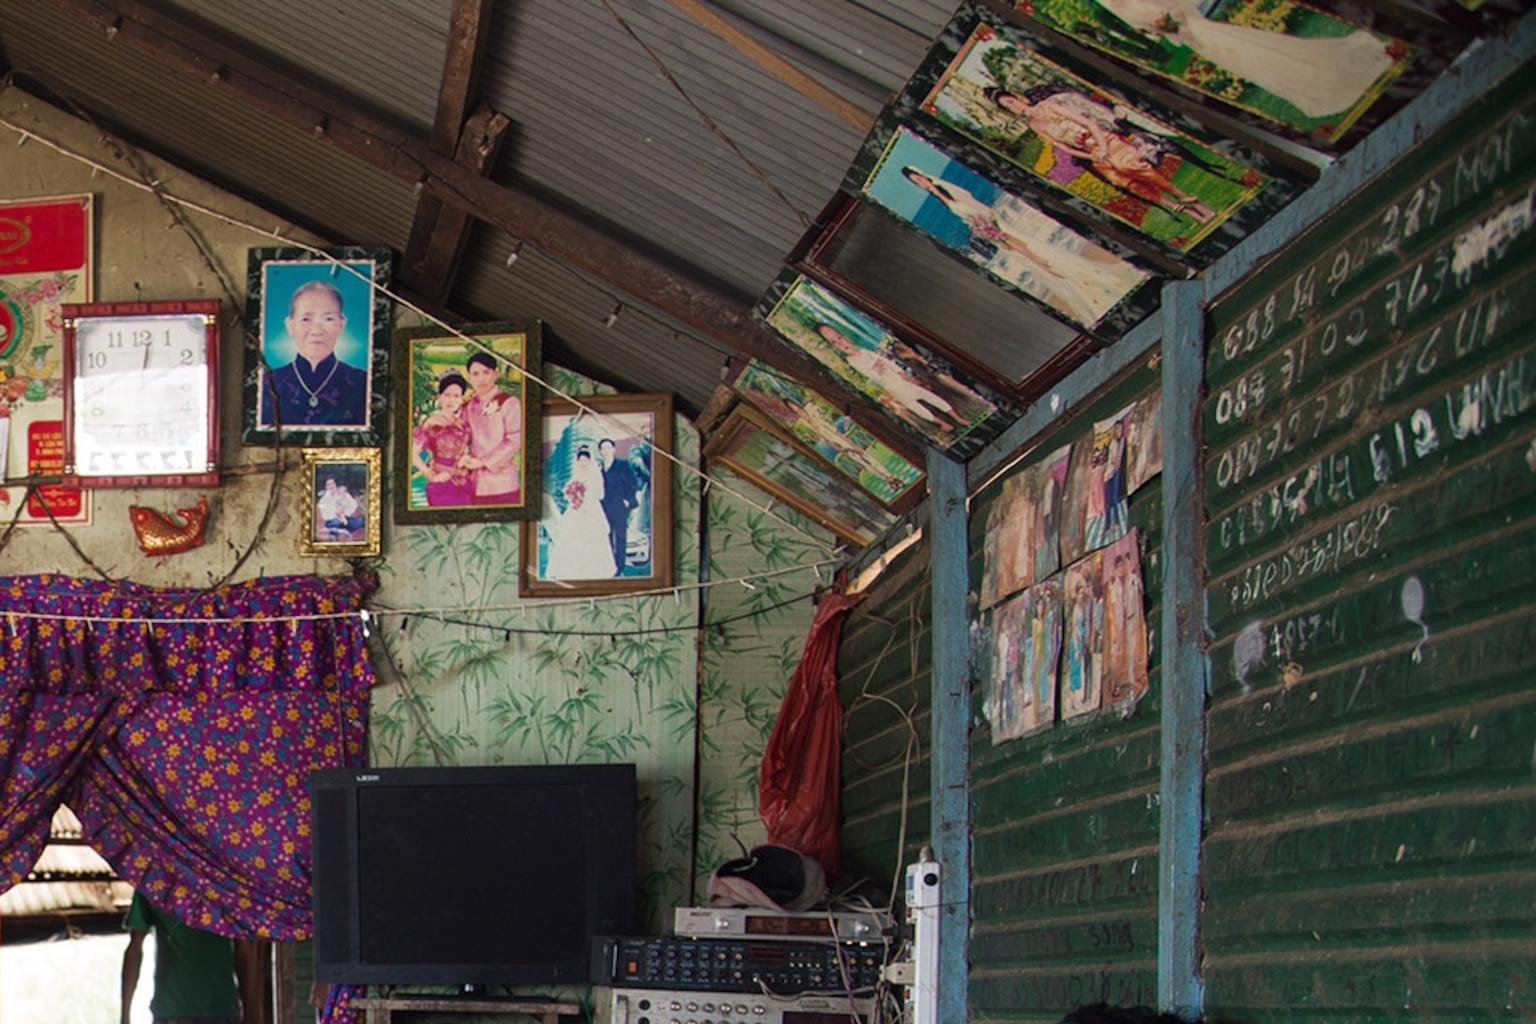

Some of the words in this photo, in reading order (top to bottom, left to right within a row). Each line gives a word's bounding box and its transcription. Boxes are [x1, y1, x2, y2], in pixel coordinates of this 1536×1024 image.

[107, 331, 123, 348] 11
[131, 329, 153, 348] 12
[163, 330, 172, 347] 1
[87, 350, 107, 369] 10
[179, 348, 194, 366] 2
